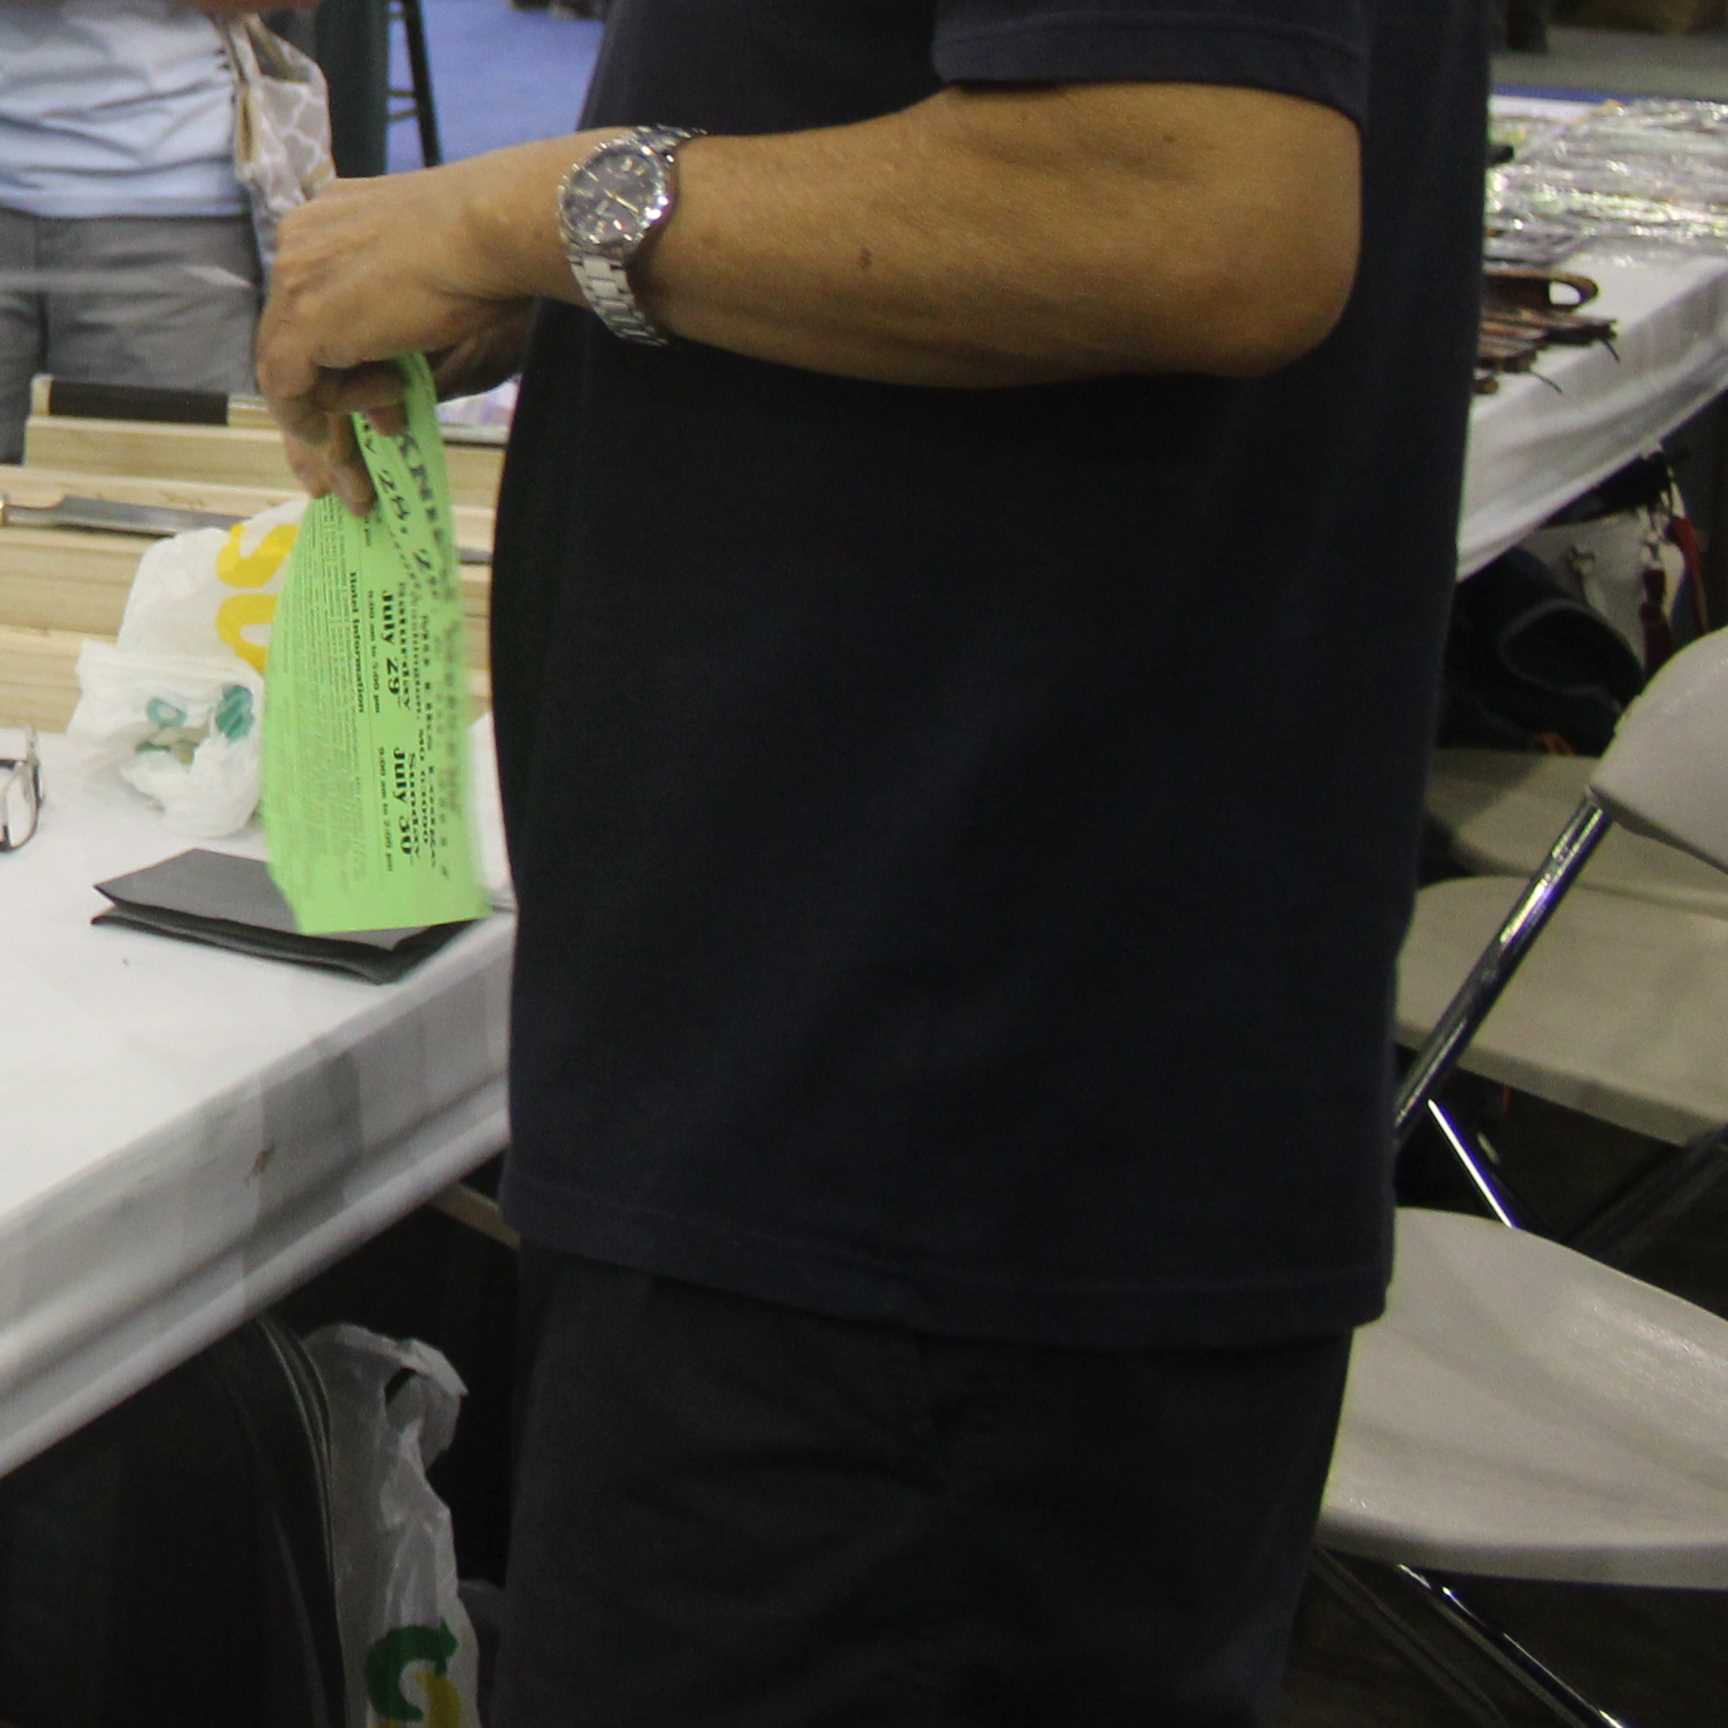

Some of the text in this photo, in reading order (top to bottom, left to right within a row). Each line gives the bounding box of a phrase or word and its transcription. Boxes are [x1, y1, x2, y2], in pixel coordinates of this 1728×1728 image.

[380, 589, 397, 646] July
[351, 618, 364, 714] Information
[392, 746, 408, 804] July
[408, 752, 421, 857] Sunday
